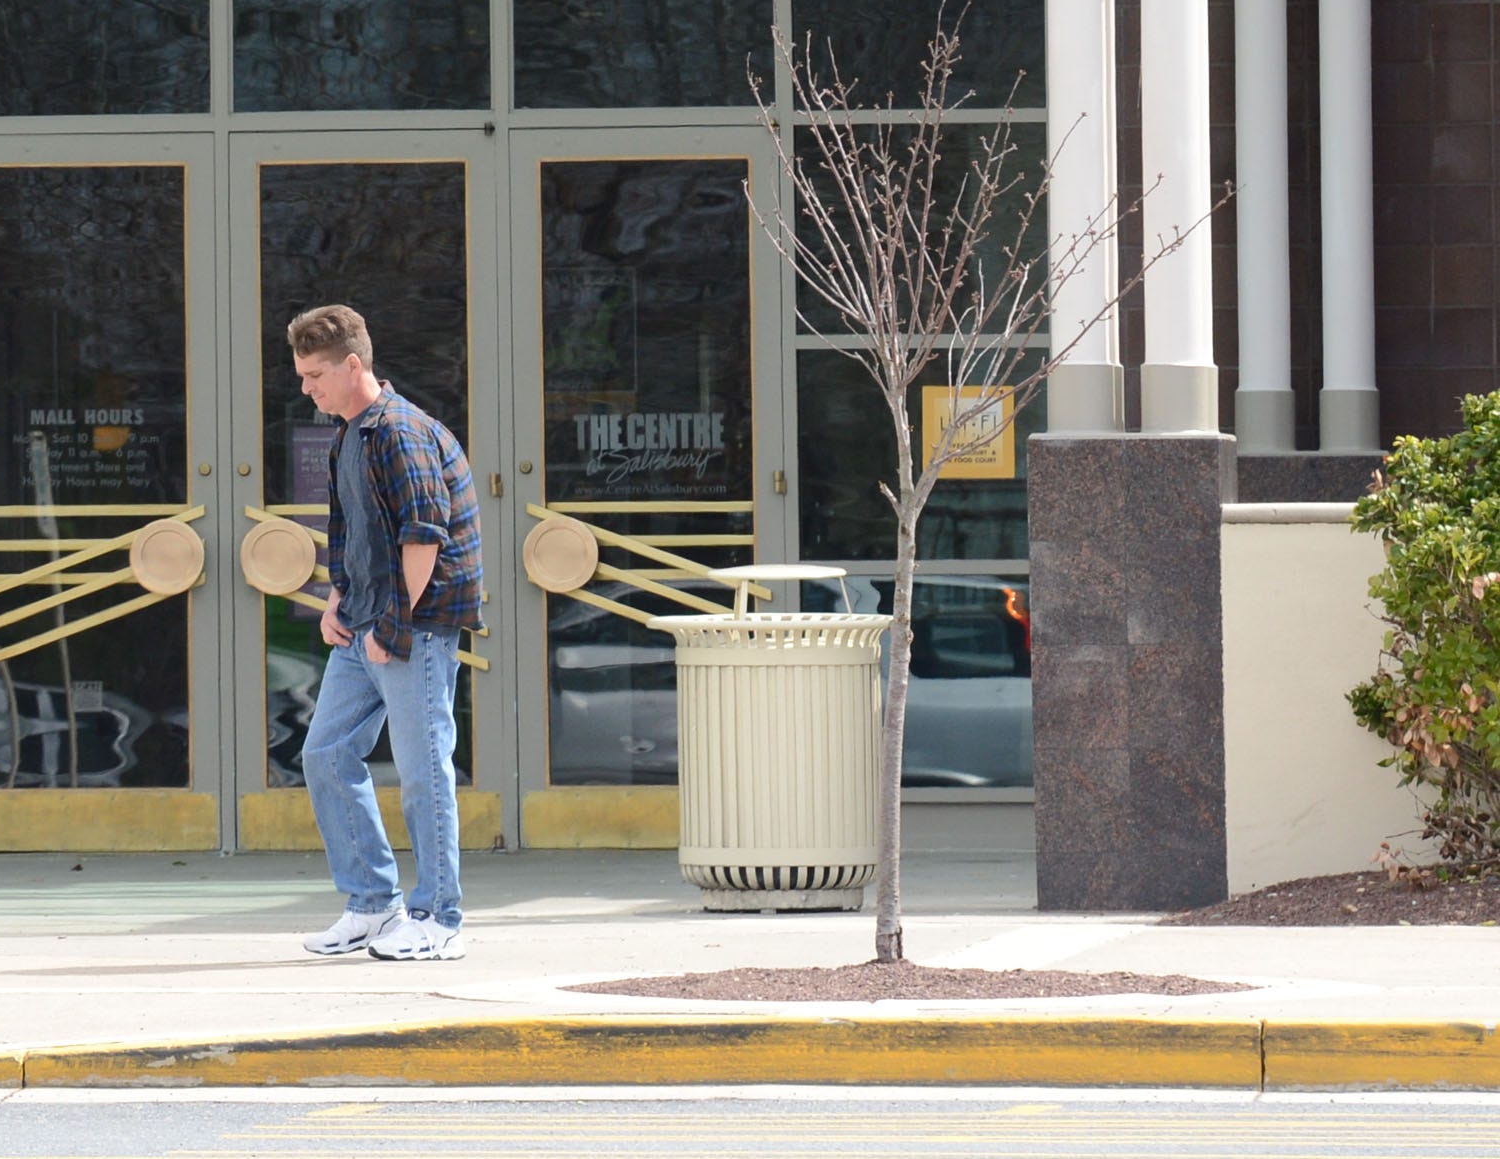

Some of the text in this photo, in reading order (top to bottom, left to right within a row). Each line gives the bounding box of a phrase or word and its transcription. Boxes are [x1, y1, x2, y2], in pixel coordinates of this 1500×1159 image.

[30, 409, 145, 425] MALL HOURS
[573, 412, 725, 450] THE CENTRE
[125, 462, 146, 472] and
[586, 447, 722, 485] at Salisbury
